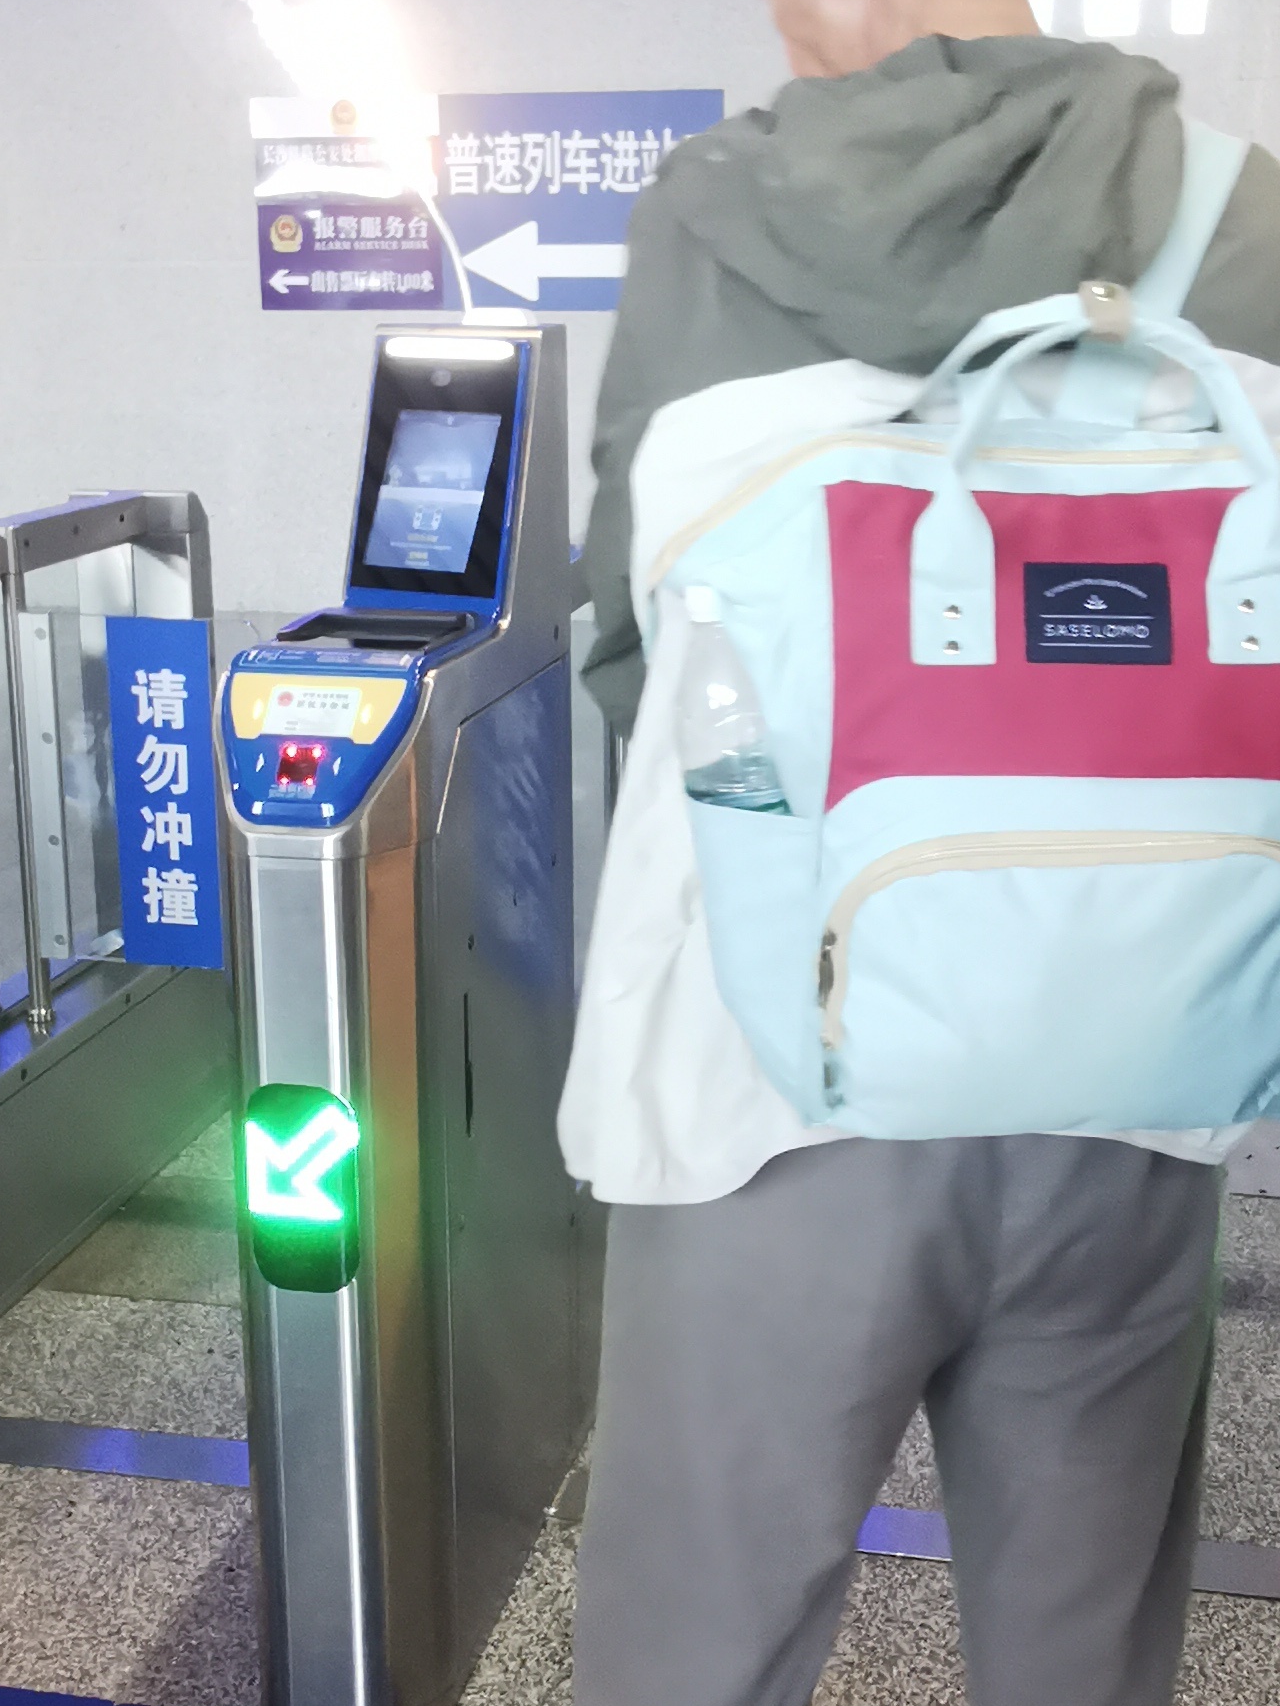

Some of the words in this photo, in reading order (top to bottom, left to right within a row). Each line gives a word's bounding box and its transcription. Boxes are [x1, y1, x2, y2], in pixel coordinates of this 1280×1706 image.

[314, 215, 428, 239] 报警服务台
[131, 668, 200, 927] 请勿冲撞
